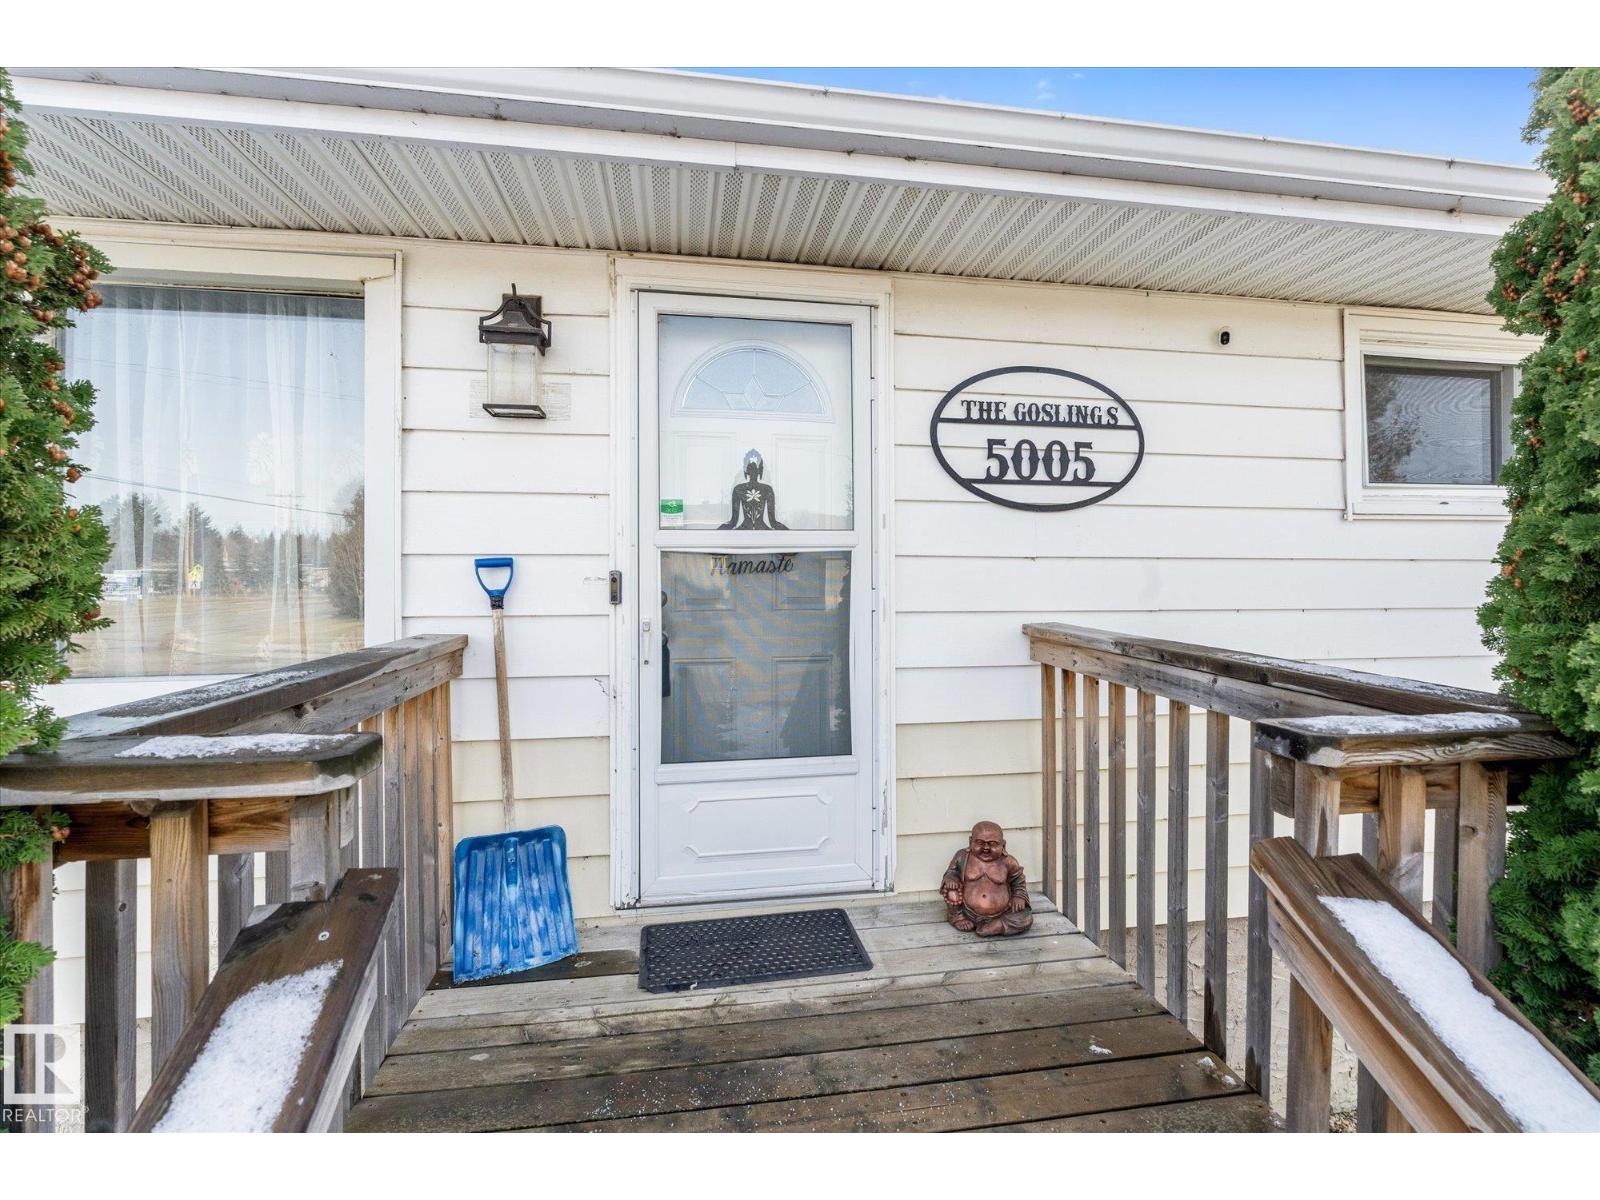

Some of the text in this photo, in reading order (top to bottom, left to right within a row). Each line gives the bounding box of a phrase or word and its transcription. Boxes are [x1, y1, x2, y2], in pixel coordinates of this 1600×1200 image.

[961, 400, 1119, 425] THE GOSLINGS
[984, 438, 1096, 482] 5005
